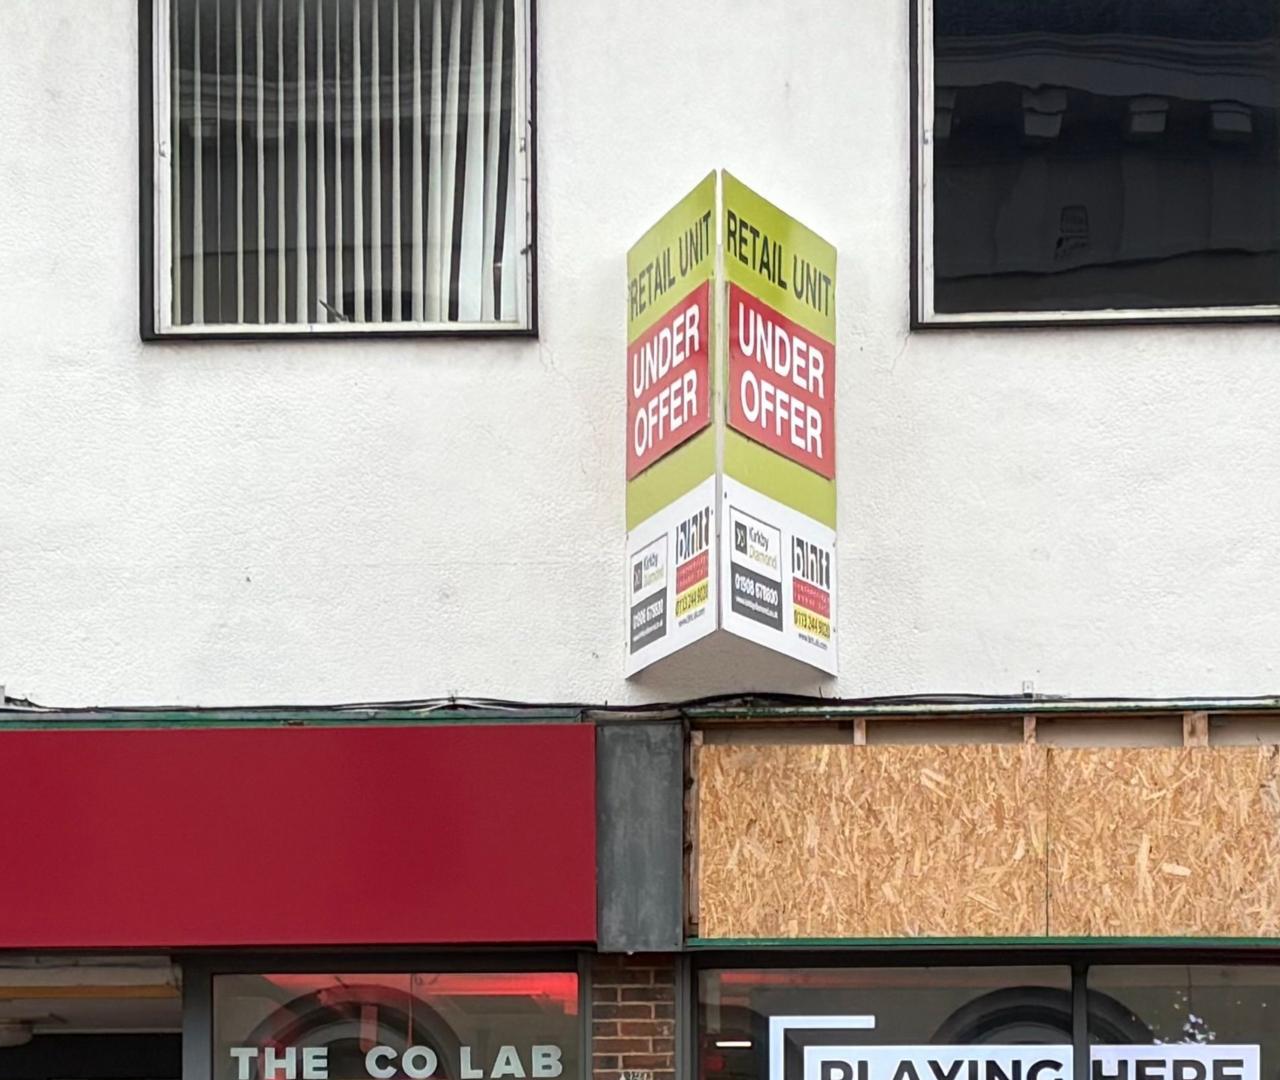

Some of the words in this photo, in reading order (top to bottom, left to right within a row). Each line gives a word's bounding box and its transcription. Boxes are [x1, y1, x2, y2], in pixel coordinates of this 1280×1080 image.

[628, 247, 676, 321] RETAIL
[679, 210, 711, 277] UNIT
[727, 209, 788, 290] RETAIL
[793, 255, 832, 317] UNIT
[633, 304, 700, 399] UNDER
[738, 302, 825, 399] UNDER
[634, 369, 698, 457] OFFER
[740, 370, 823, 458] OFFER
[230, 1047, 329, 1080] THE
[365, 1045, 438, 1080] CO
[460, 1045, 564, 1080] LAB
